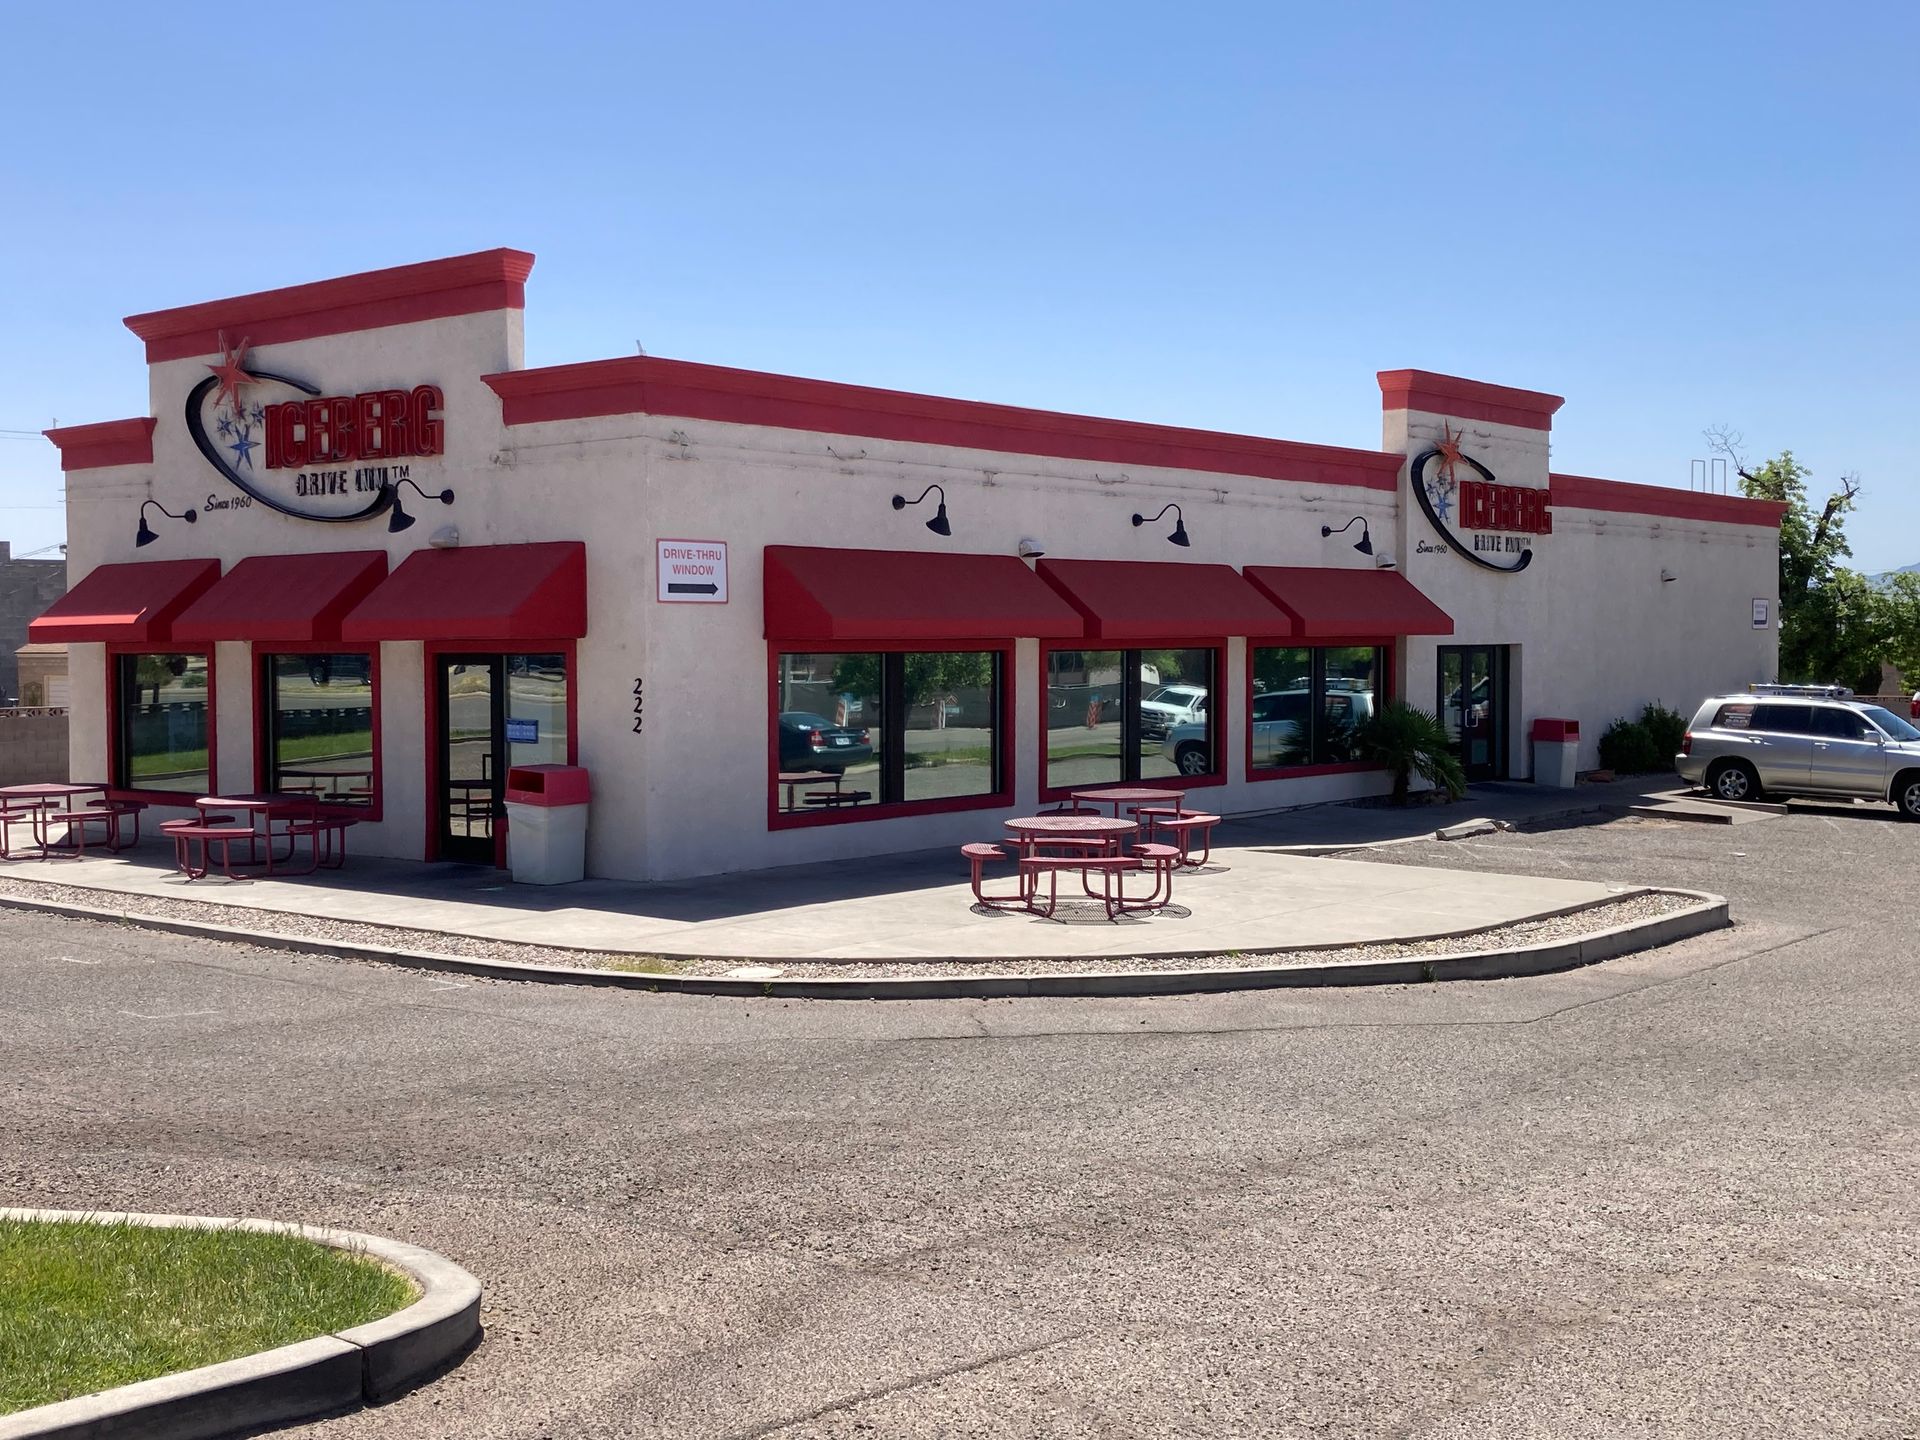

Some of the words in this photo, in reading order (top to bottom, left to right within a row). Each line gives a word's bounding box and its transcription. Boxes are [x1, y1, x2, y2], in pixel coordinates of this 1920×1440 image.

[265, 384, 444, 469] ICEBERG
[296, 470, 348, 496] DRIVE
[204, 494, 230, 511] Since
[231, 496, 252, 510] 1960
[1460, 481, 1552, 535] ICEBERG
[1474, 534, 1502, 552] DRIVE
[663, 548, 721, 561] DRIVE-THRU
[672, 564, 714, 576] WINDOW
